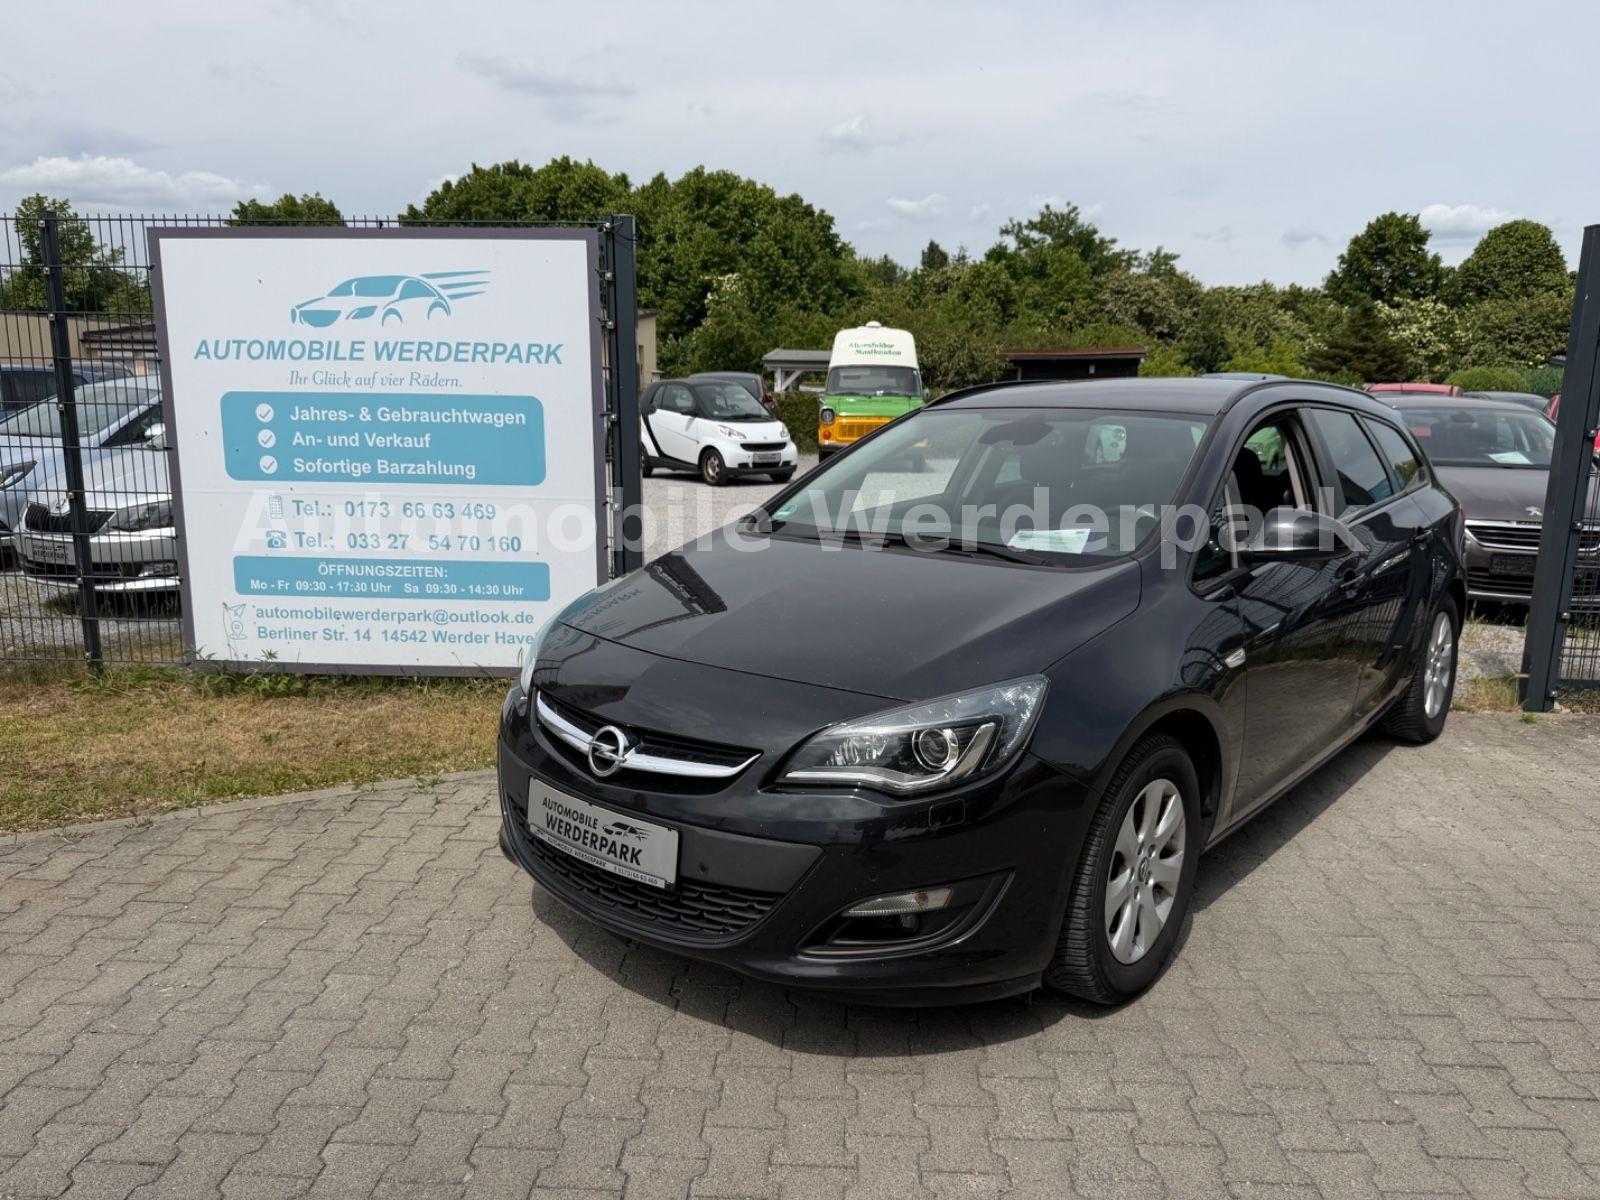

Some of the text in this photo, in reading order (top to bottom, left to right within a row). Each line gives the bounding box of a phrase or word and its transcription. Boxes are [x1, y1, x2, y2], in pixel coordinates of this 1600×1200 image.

[194, 339, 564, 365] AUTOMOBILE WERDERPARK
[289, 370, 463, 389] Ihr Glück auf vier Rädern.
[290, 406, 527, 427] Jahres- & Gebrauchtwagen
[292, 431, 431, 448] An- und Verkauf
[293, 458, 476, 479] Sofortige Barzahlung
[292, 499, 497, 520] Tel.: 0173 66 63 469
[294, 531, 522, 553] Tel.: 033 27 54 70 160
[318, 562, 449, 578] ÖFFNUNGSZEITEN:
[250, 579, 268, 590] Mo
[278, 580, 290, 590] Fr
[296, 580, 326, 592] 09:30
[337, 581, 368, 593] 17:30
[371, 581, 392, 593] Uhr
[404, 583, 420, 594] Sa
[425, 583, 457, 595] 09:30
[468, 585, 500, 596] 14:30
[503, 585, 525, 596] Uhr
[256, 606, 535, 626] automobilewerderpark@outlook.de
[257, 626, 535, 645] Berliner Str. 14 14542 Werder Have
[542, 796, 599, 830] AUTOMOBILE
[545, 811, 643, 867] WERDERPARK
[574, 850, 607, 868] WERDERPARK
